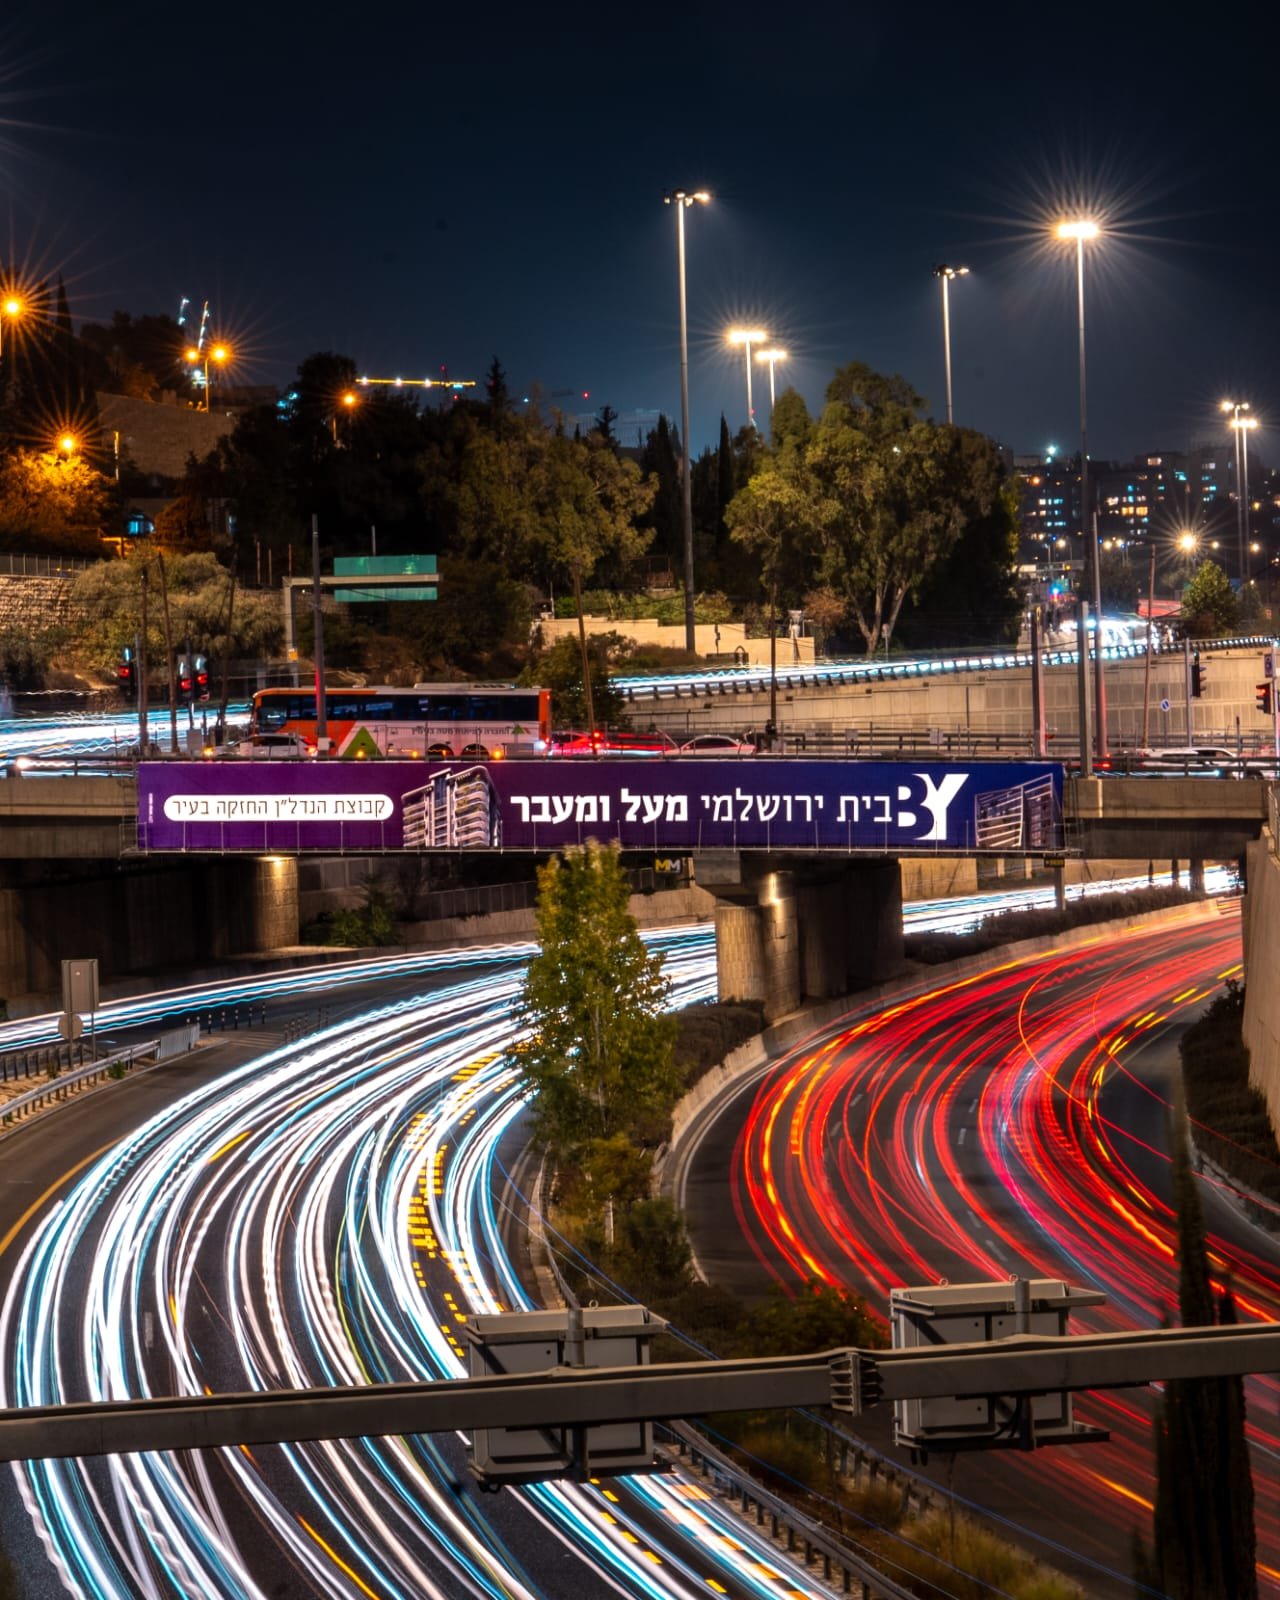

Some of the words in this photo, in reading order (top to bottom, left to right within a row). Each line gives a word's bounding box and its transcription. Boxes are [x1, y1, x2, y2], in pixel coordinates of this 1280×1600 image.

[172, 800, 209, 816] בעיר
[216, 800, 268, 819] החזקה
[334, 800, 385, 819] קבוצת
[510, 795, 610, 825] ומעבר
[620, 788, 688, 824] מעל
[700, 787, 824, 823] ירושלמי
[836, 795, 893, 823] בית
[897, 773, 969, 840] BY
